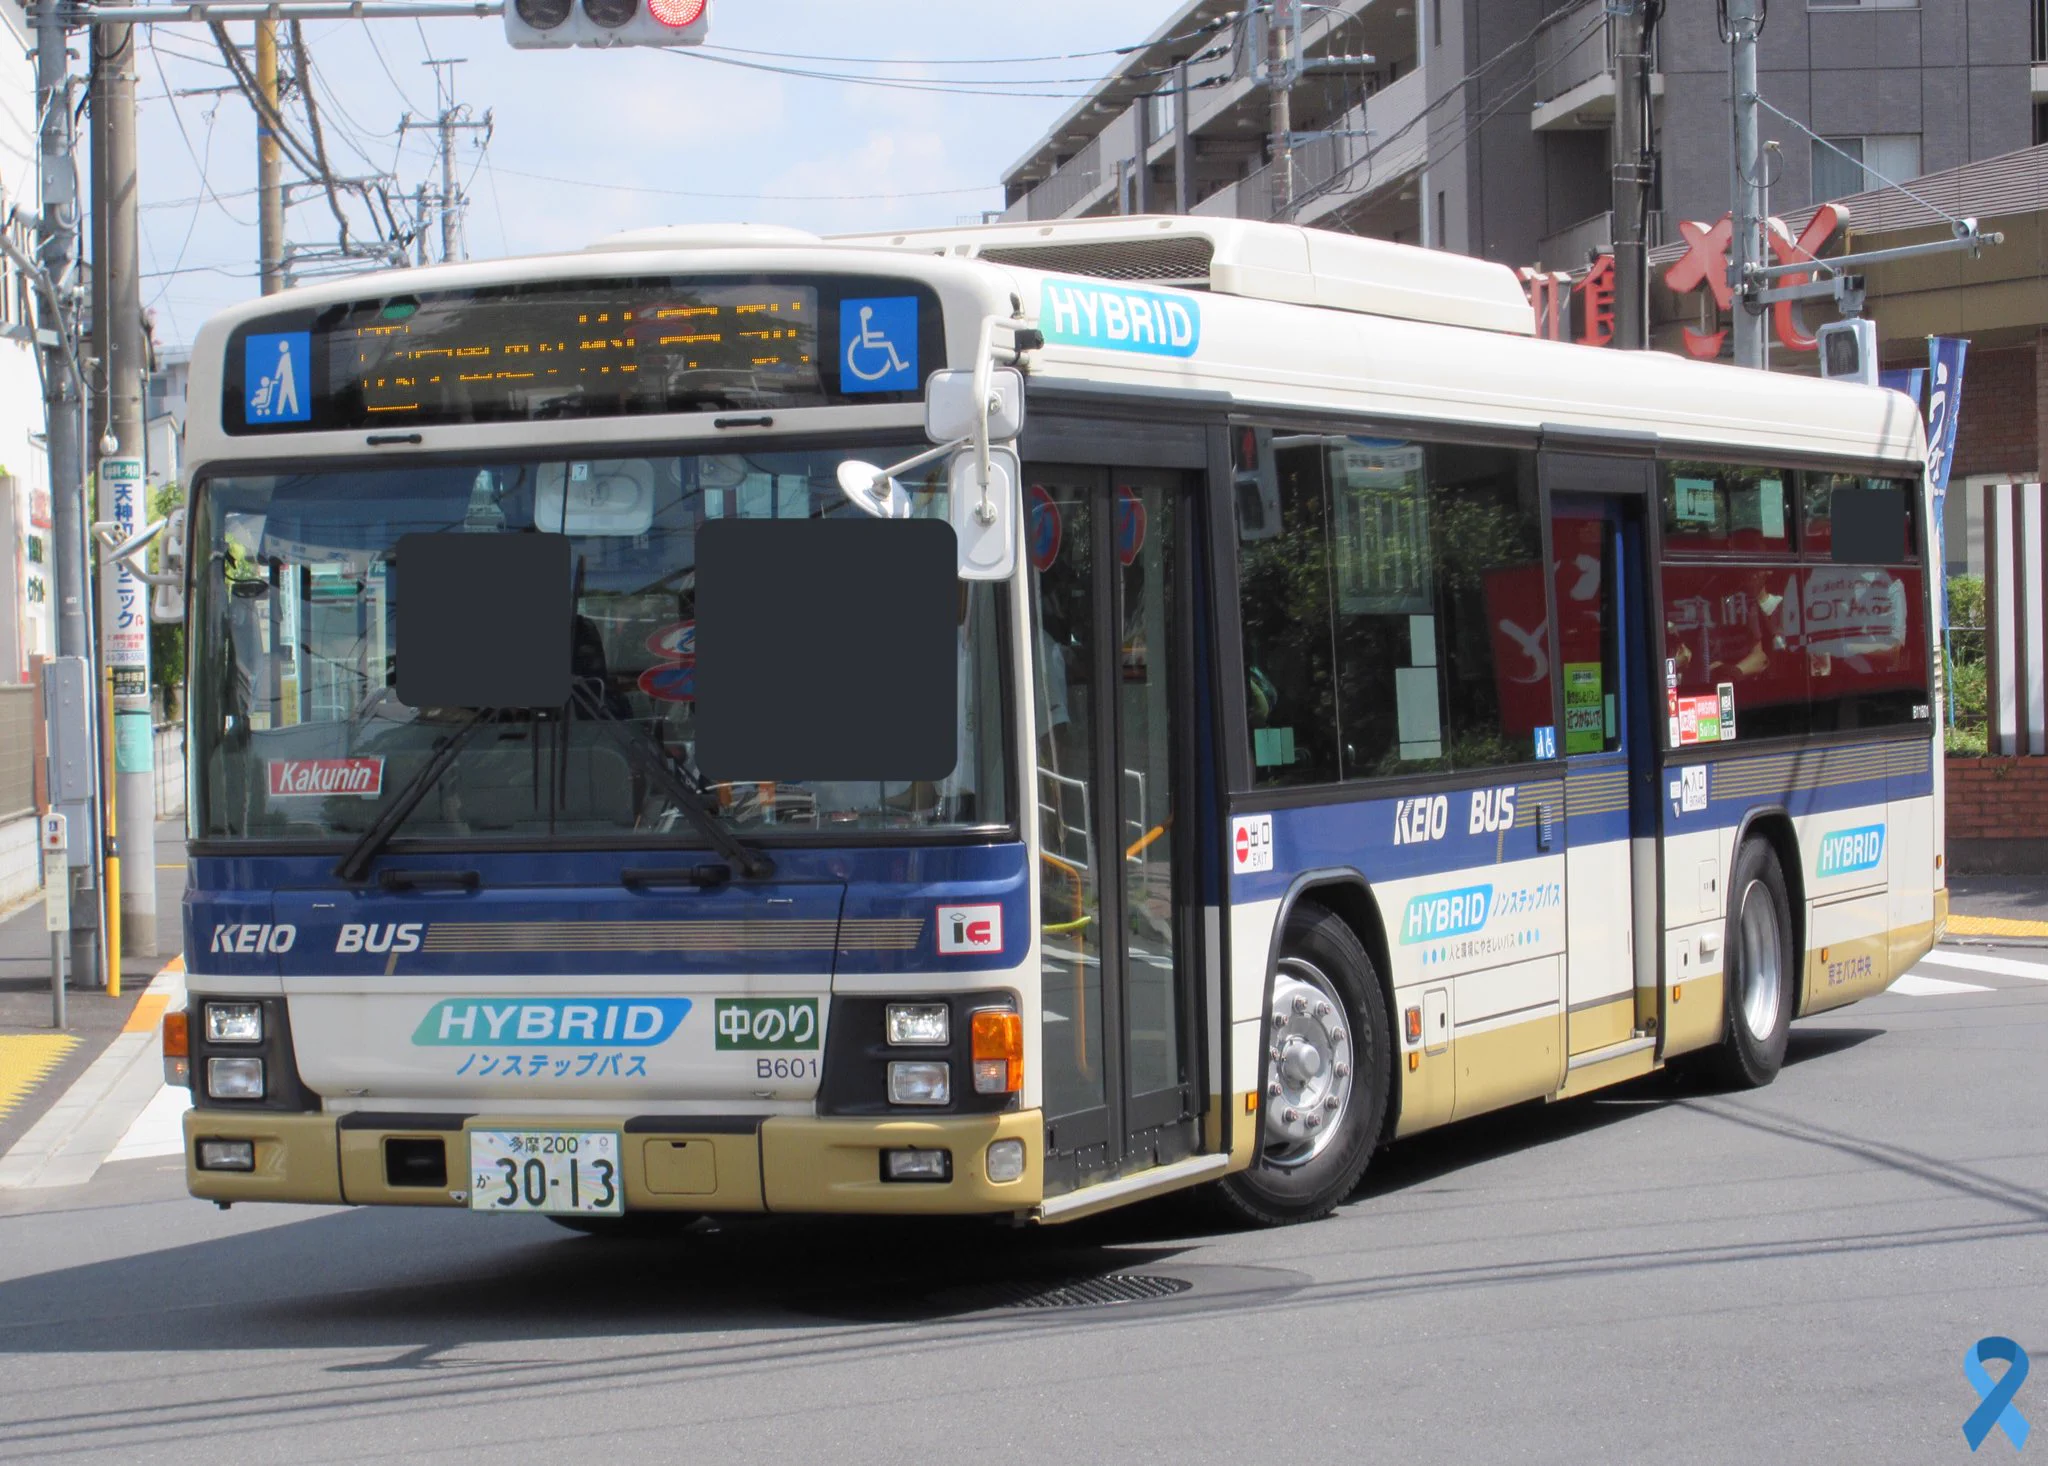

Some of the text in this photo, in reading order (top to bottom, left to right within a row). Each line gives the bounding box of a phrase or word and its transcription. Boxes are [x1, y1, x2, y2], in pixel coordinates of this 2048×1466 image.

[1048, 285, 1193, 348] HYBRID
[279, 761, 371, 792] Kakunin
[1393, 787, 1515, 846] KEIO BUS
[1250, 821, 1270, 848] 出口
[1823, 831, 1880, 871] HYBRID
[1252, 851, 1267, 867] EXIT
[1408, 893, 1485, 938] HYBRID
[1492, 882, 1561, 918] ノンステップバス
[210, 923, 423, 954] KEIO BUS
[1448, 933, 1517, 961] 人と環境にやさしいバス
[1828, 955, 1873, 987] 京王バス中央
[438, 1005, 665, 1040] HYBRID
[719, 1004, 815, 1043] 中のり
[456, 1052, 648, 1078] ノンステップバス
[757, 1058, 818, 1079] B601
[476, 1157, 615, 1208] か 30-13
